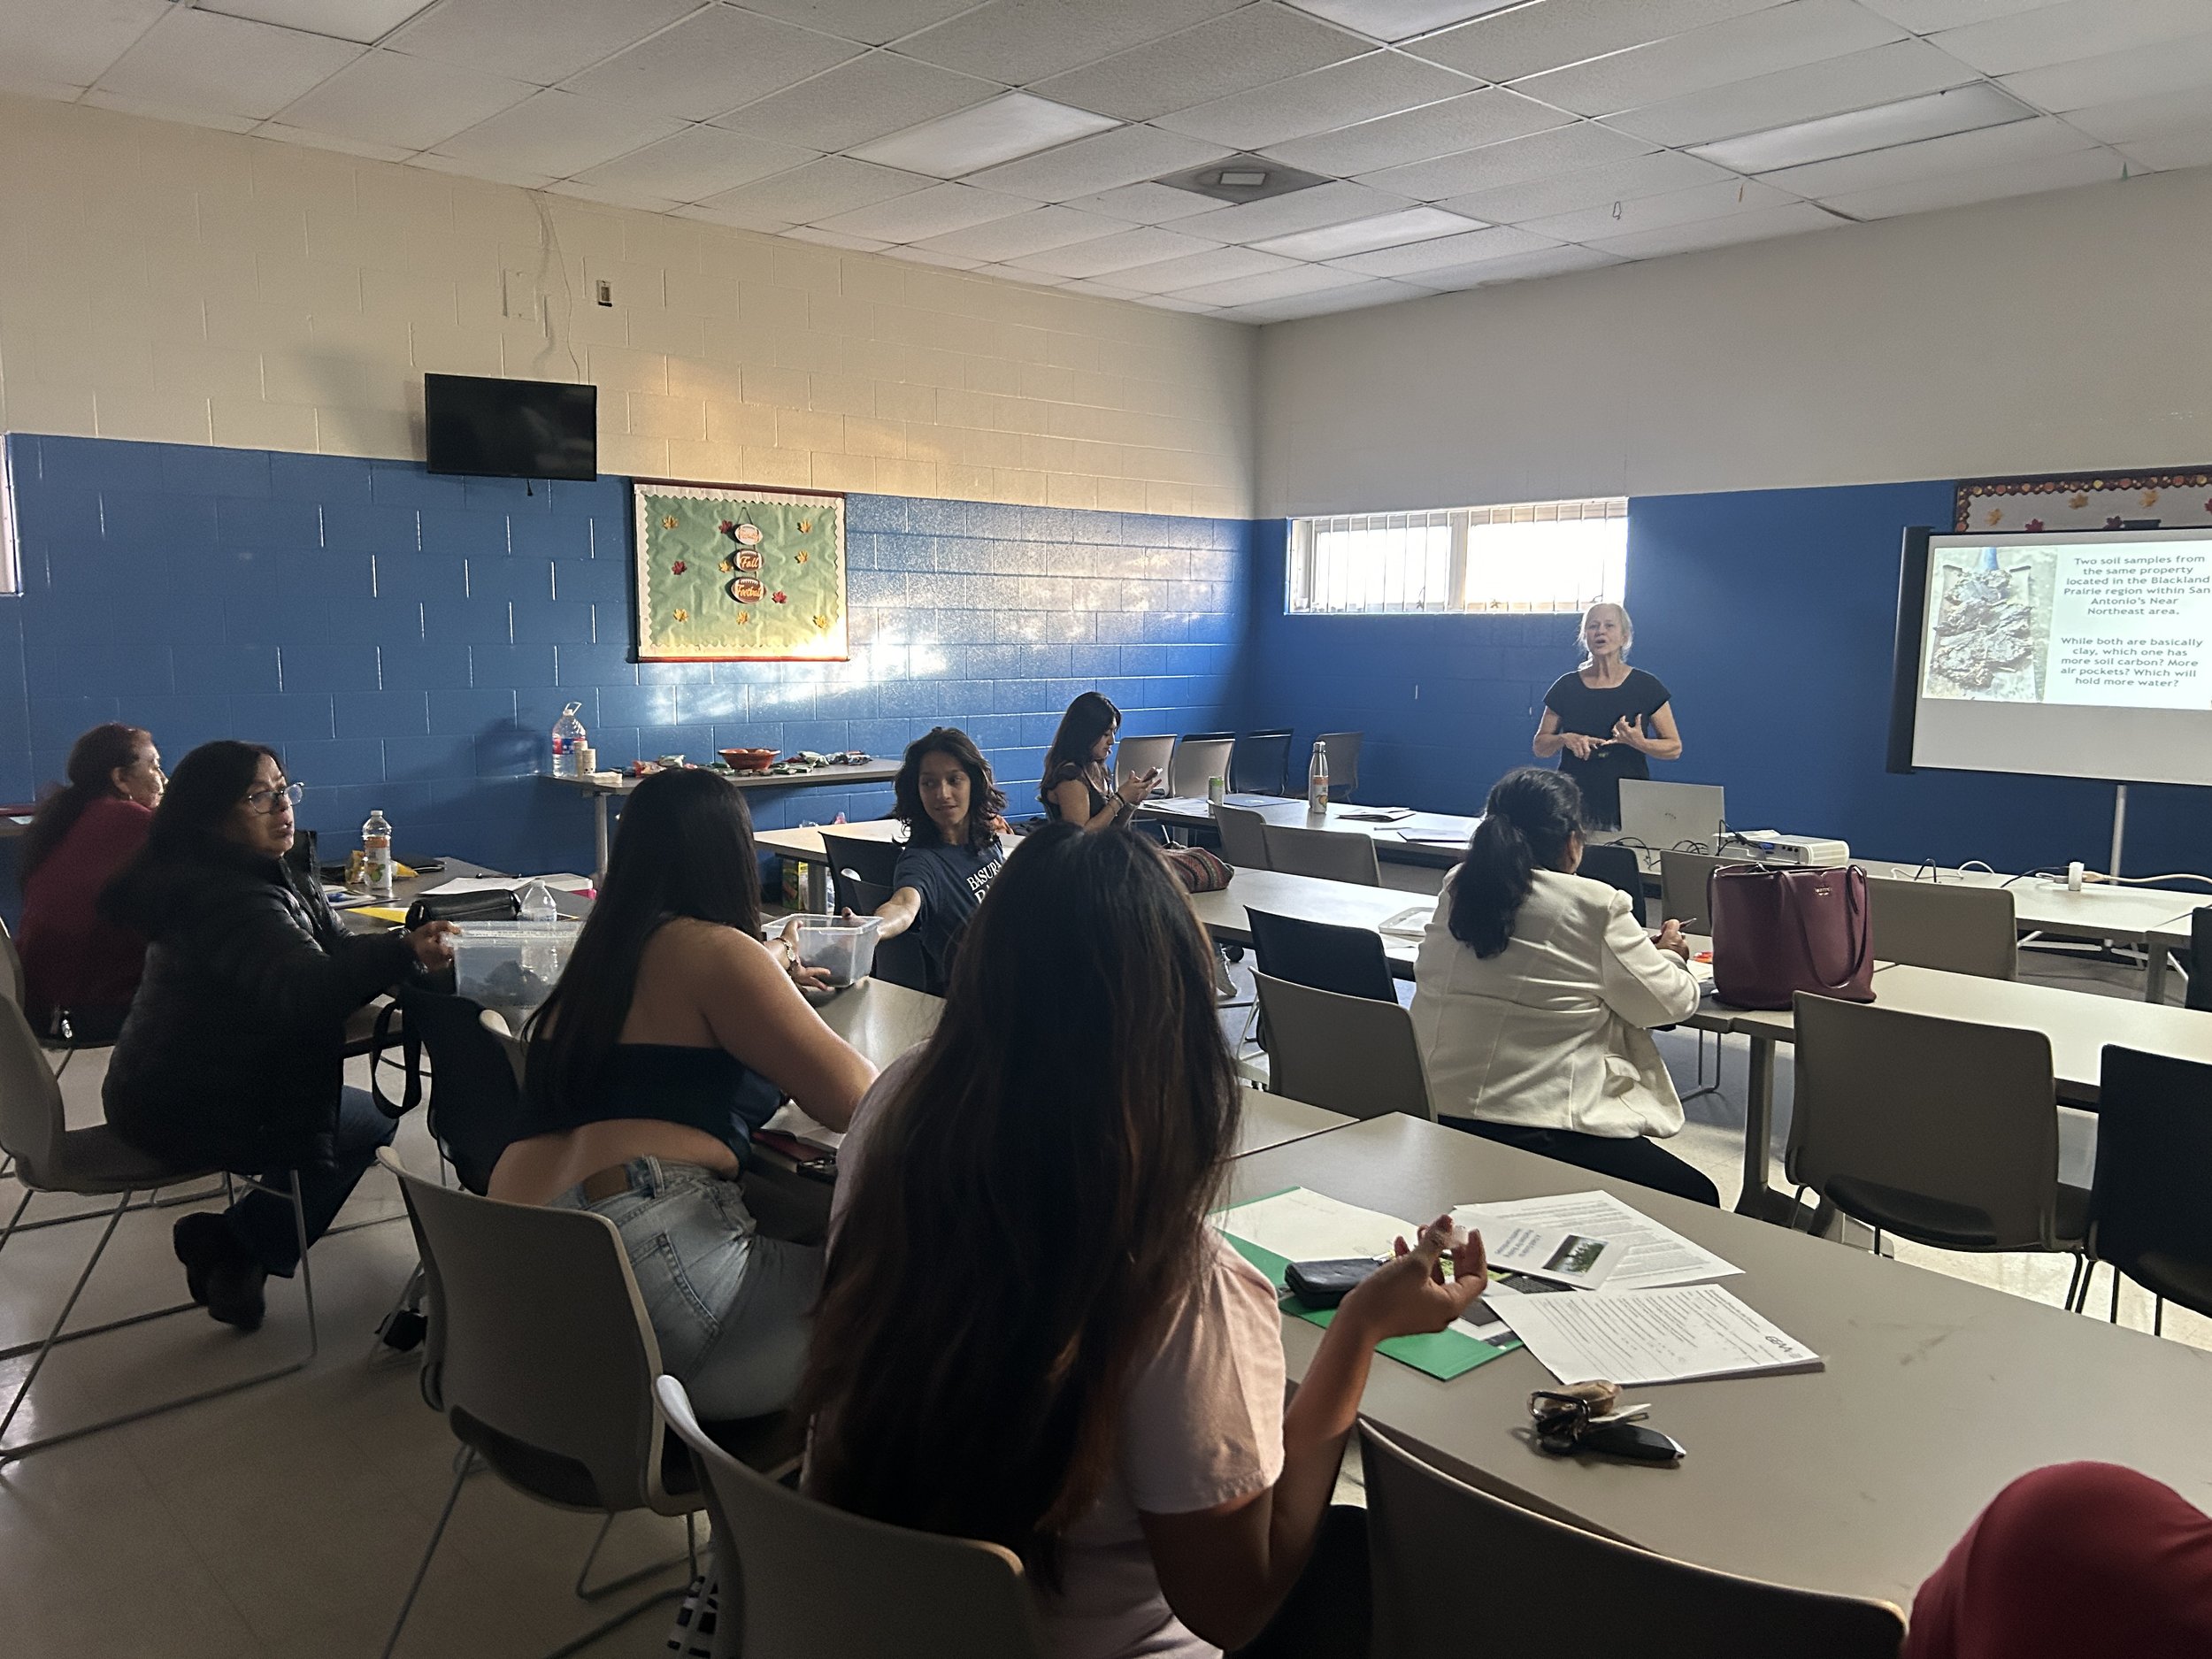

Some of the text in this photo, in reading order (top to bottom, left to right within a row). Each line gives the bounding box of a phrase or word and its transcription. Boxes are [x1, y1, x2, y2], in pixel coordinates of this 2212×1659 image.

[741, 556, 759, 568] Fall
[2100, 557, 2121, 565] soil
[2124, 555, 2172, 565] samples
[2176, 555, 2206, 564] from
[2139, 566, 2194, 576] property
[2066, 577, 2109, 586] located
[2151, 575, 2210, 585] Blackland
[2105, 587, 2143, 596] region
[2146, 586, 2185, 595] within
[2188, 586, 2211, 595] San
[2090, 596, 2179, 605] Antonio's Near
[2087, 607, 2145, 616] Northeast
[2096, 637, 2124, 646] both
[2150, 638, 2203, 649] basically
[2072, 647, 2099, 657] clay,
[2167, 658, 2199, 667] More
[2078, 667, 2131, 676] pockets?
[2133, 668, 2170, 677] Which
[2138, 679, 2179, 687] water?
[966, 858, 1002, 891] BASURA
